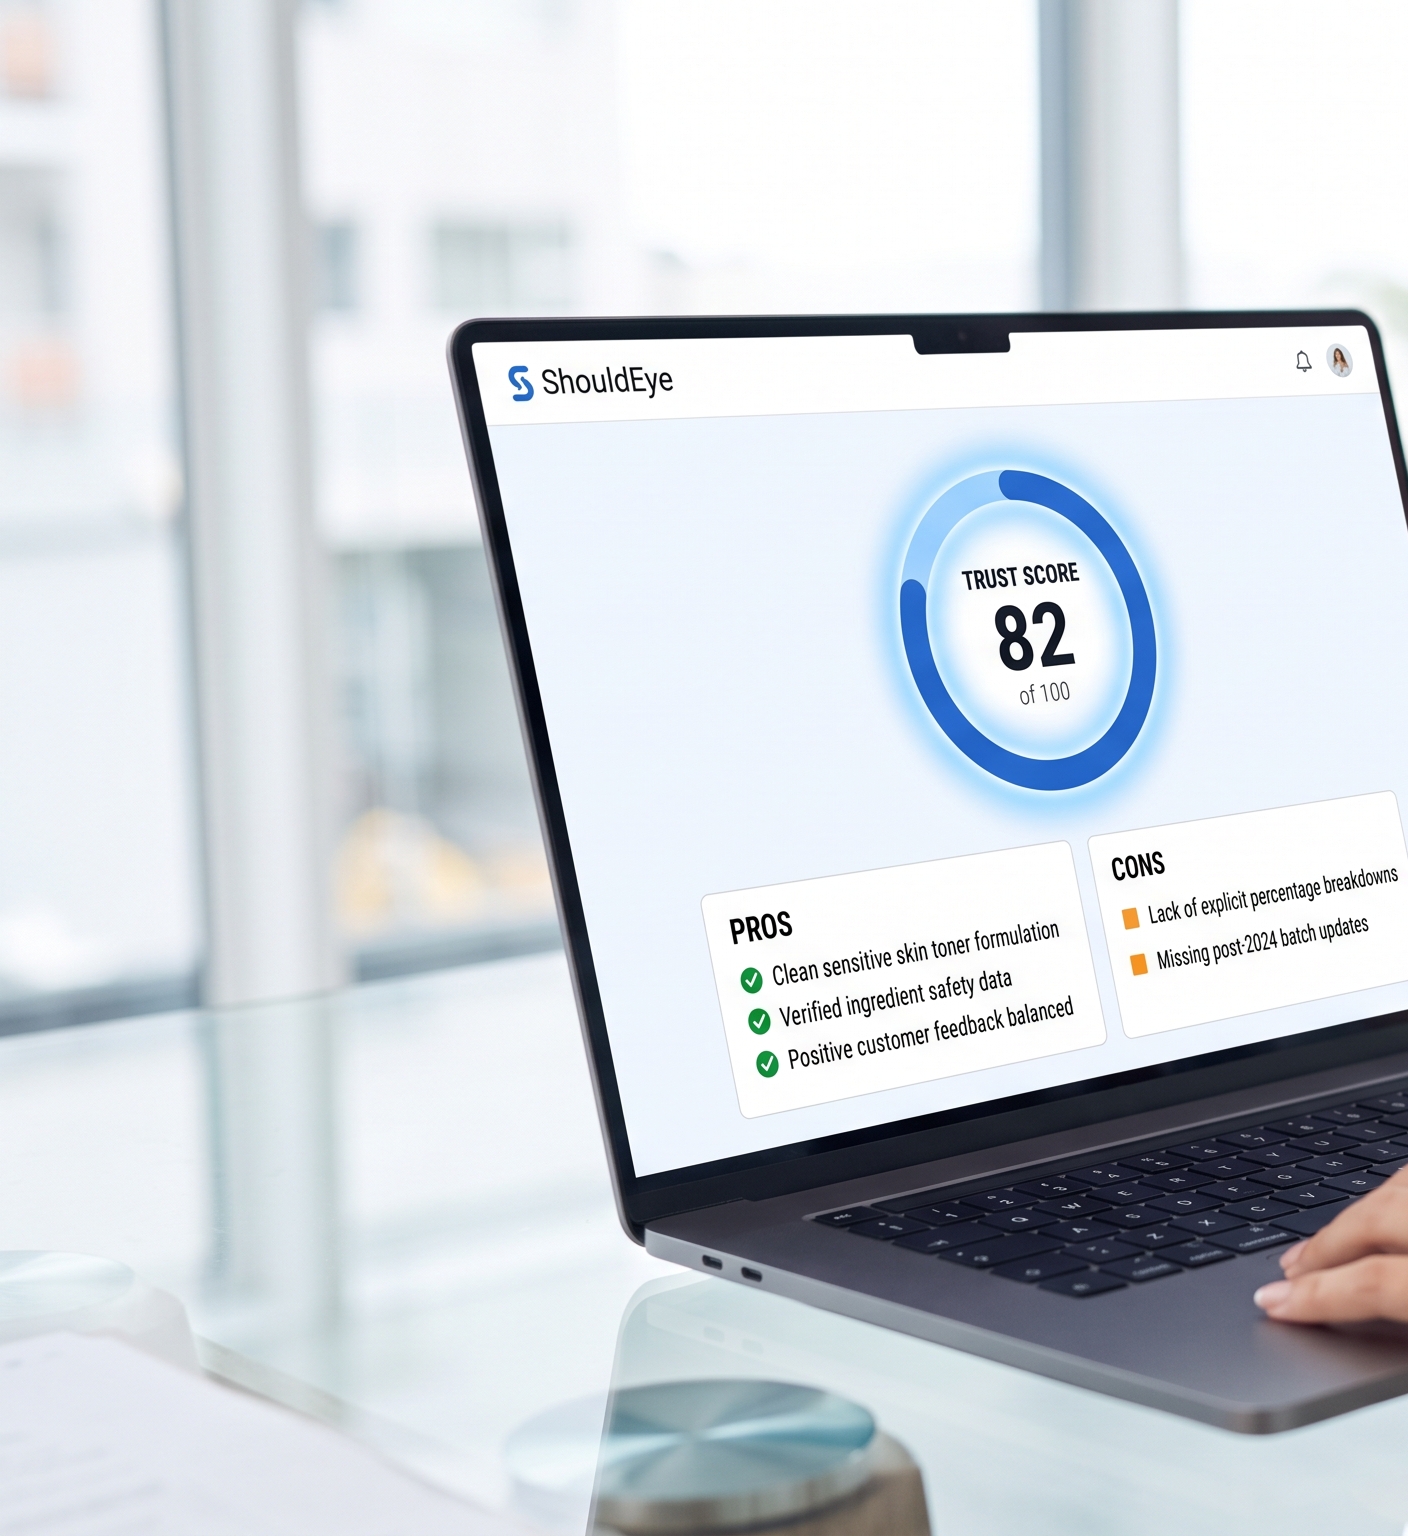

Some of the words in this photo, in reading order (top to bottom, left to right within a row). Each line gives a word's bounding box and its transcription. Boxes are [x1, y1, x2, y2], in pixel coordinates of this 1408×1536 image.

[541, 366, 674, 399] ShouldEye
[961, 567, 1018, 590] TRUST
[1023, 562, 1080, 586] SCORE
[994, 601, 1076, 671] 82
[1019, 684, 1036, 705] of
[1040, 681, 1070, 702] 100
[1111, 851, 1166, 881] CONS
[1148, 901, 1182, 924] Lack
[1184, 897, 1198, 918] of
[1200, 891, 1249, 917] explicit
[1250, 881, 1322, 911] percentage
[1322, 868, 1399, 894] breakdowns
[729, 911, 793, 945] PROS
[772, 963, 820, 986] Clean
[823, 949, 893, 977] sensitive
[896, 943, 929, 965] skin
[930, 938, 970, 959] toner
[973, 921, 1060, 952] formulation
[1156, 946, 1211, 969] Missing
[1212, 931, 1278, 965] post-2024
[1280, 923, 1317, 947] batch
[1318, 917, 1370, 943] updates
[779, 996, 842, 1028] Verified
[846, 983, 926, 1018] ingredient
[928, 976, 975, 1000] safety
[978, 970, 1013, 991] data
[788, 1041, 853, 1069] Positive
[857, 1027, 930, 1057] customer
[934, 1009, 1006, 1041] feedback
[1006, 995, 1075, 1027] balanced
